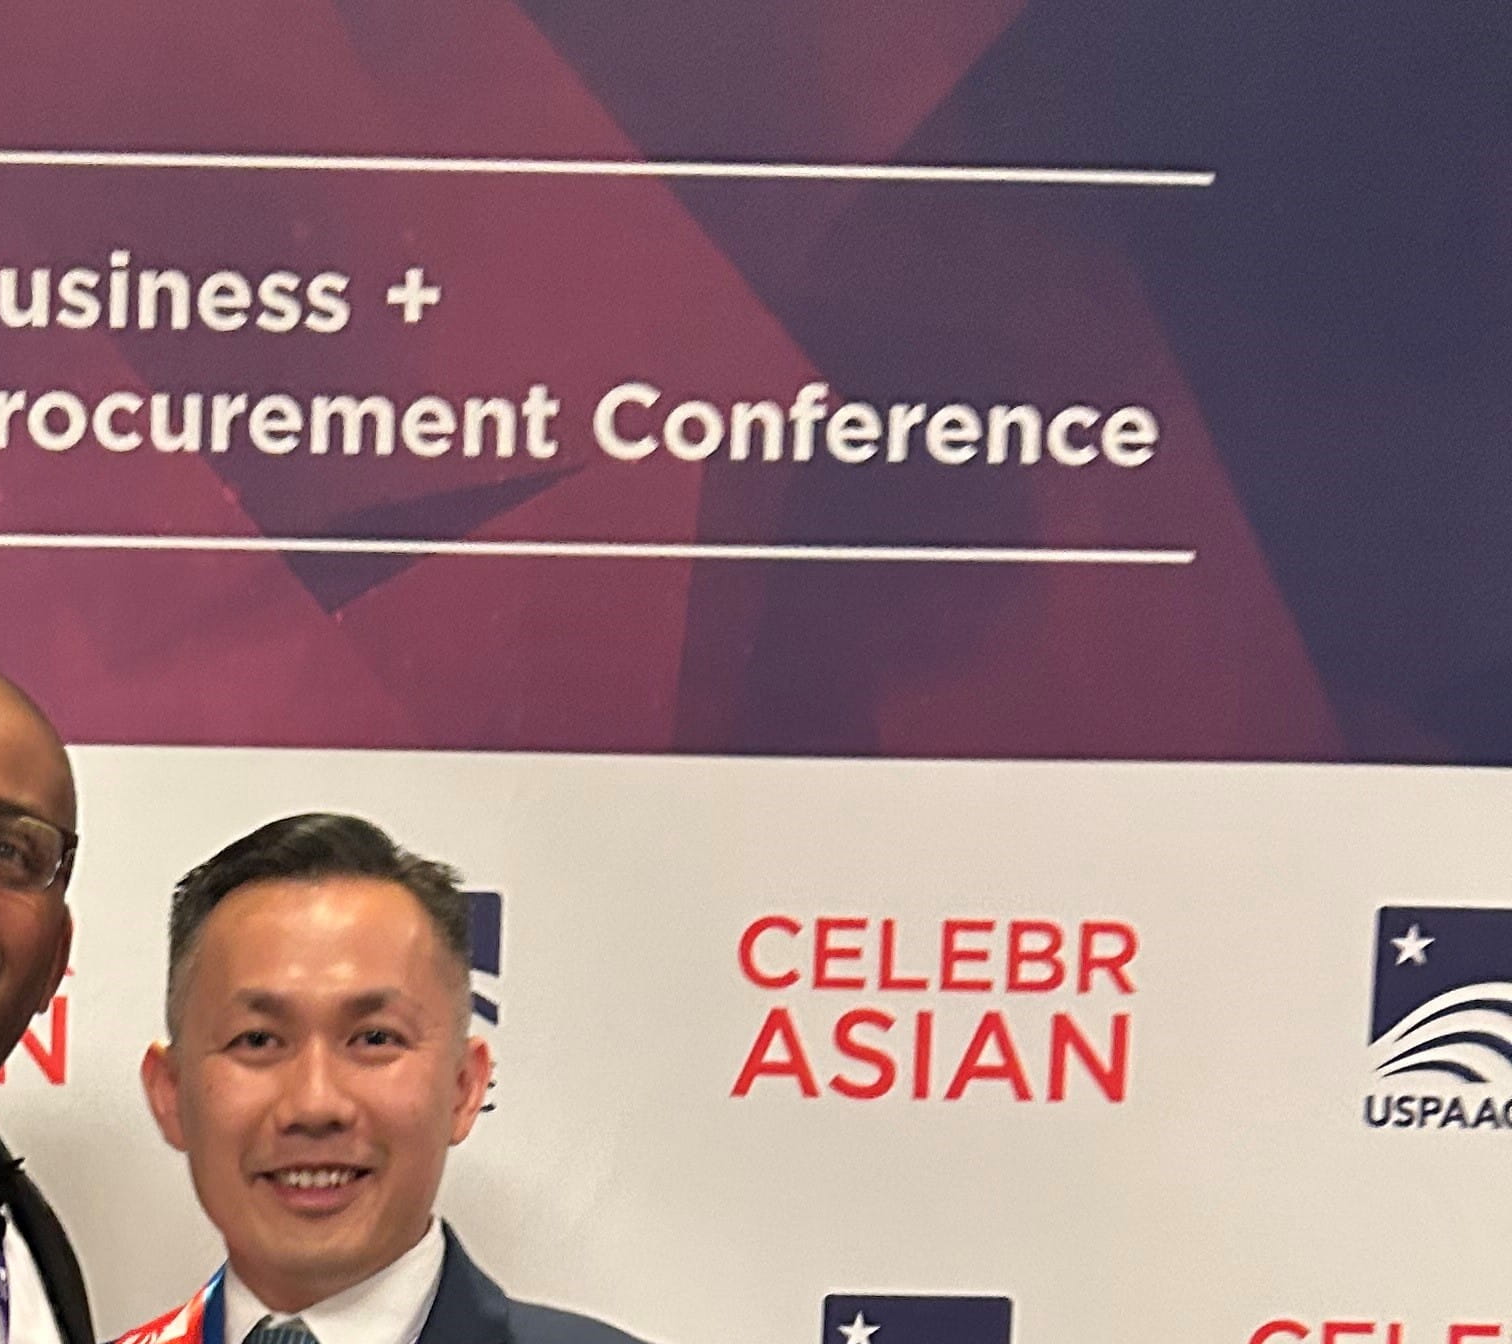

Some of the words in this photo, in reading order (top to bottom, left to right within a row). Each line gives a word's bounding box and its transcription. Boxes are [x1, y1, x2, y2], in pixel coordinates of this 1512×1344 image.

[592, 382, 1159, 468] Conference
[737, 914, 1140, 995] CELEBR
[731, 1006, 1130, 1104] ASIAN
